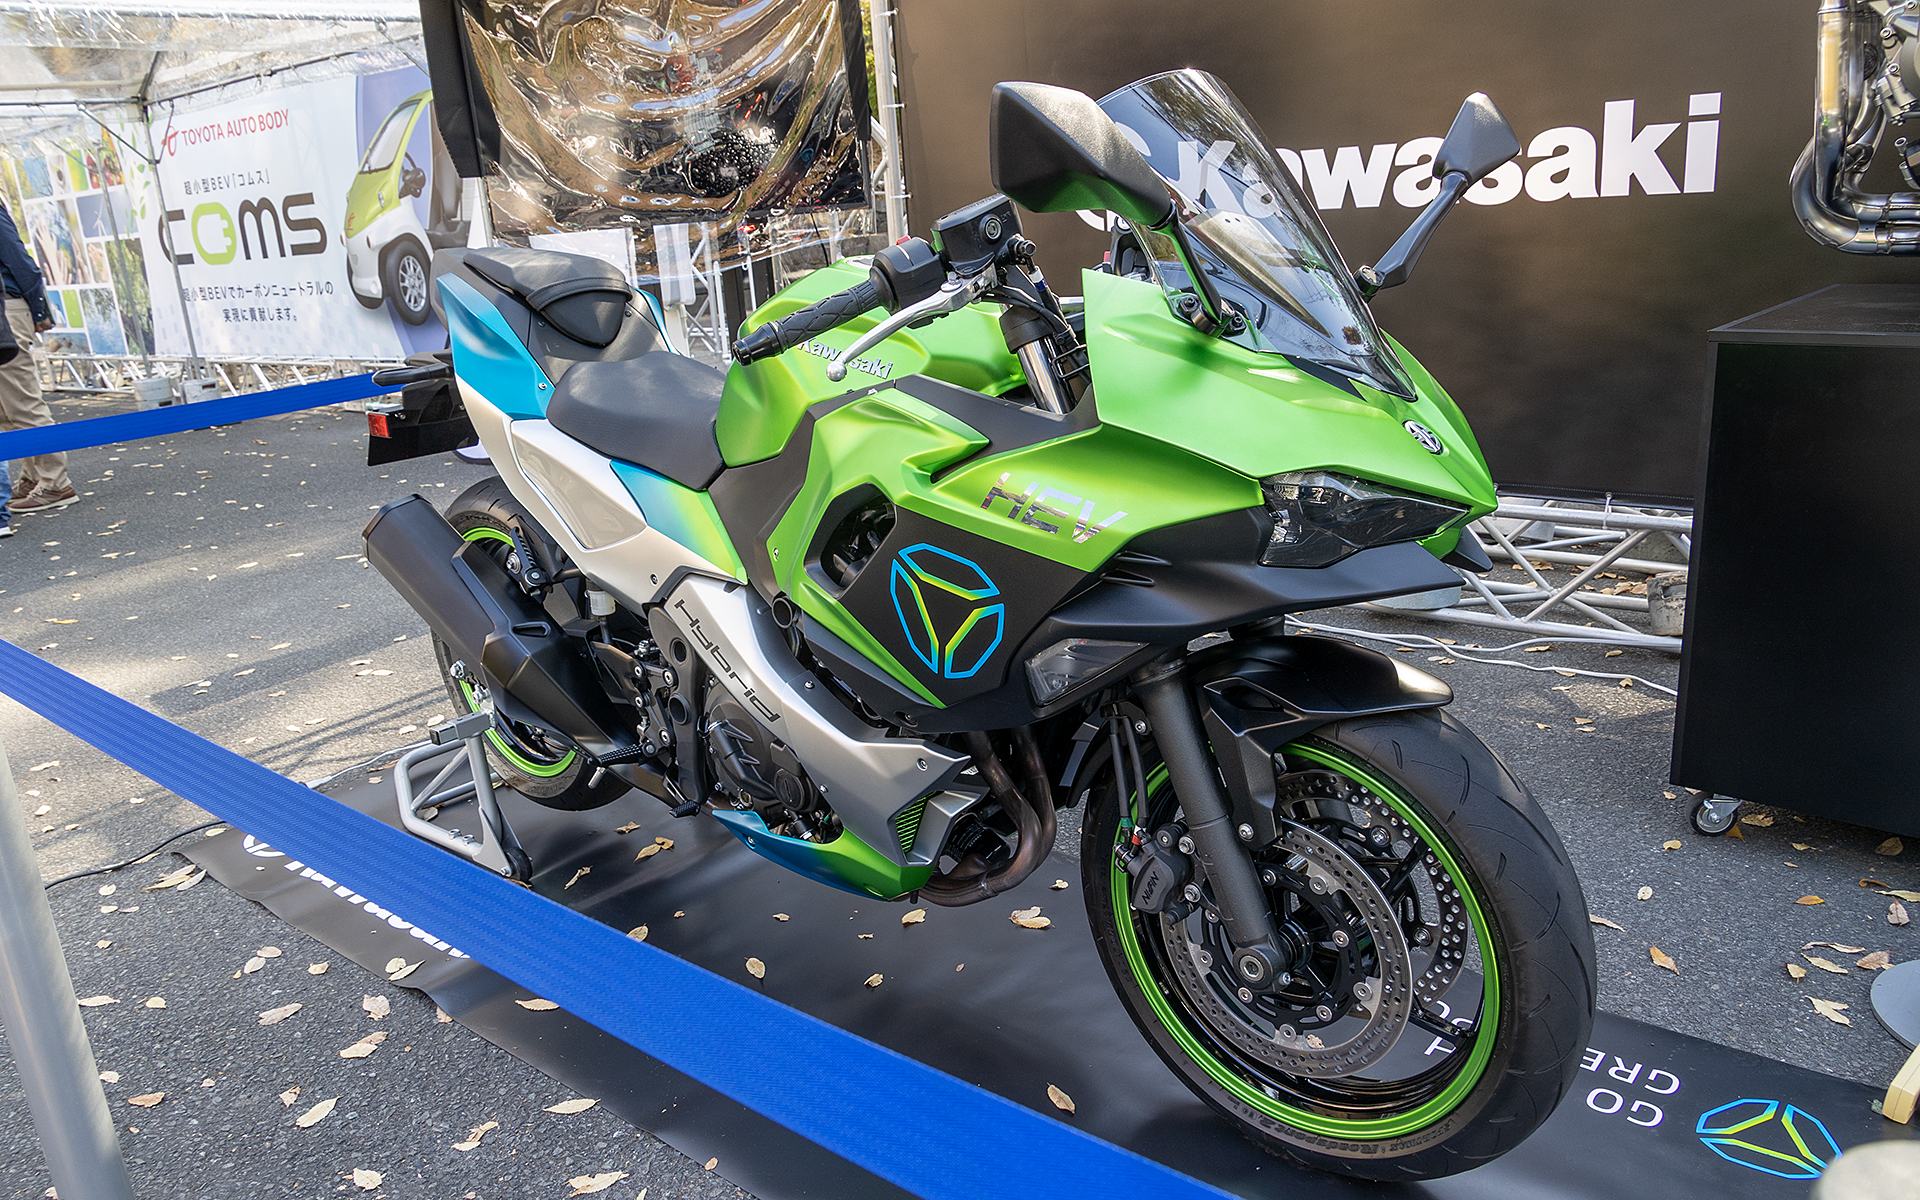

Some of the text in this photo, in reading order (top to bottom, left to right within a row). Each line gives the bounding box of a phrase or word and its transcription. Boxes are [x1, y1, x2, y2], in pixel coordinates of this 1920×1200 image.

[181, 109, 289, 147] TOYOTA AUTO BODY
[797, 336, 894, 380] Kawsaki
[980, 471, 1129, 544] HEV
[674, 599, 781, 723] Hybrid
[1586, 1087, 1665, 1129] GO
